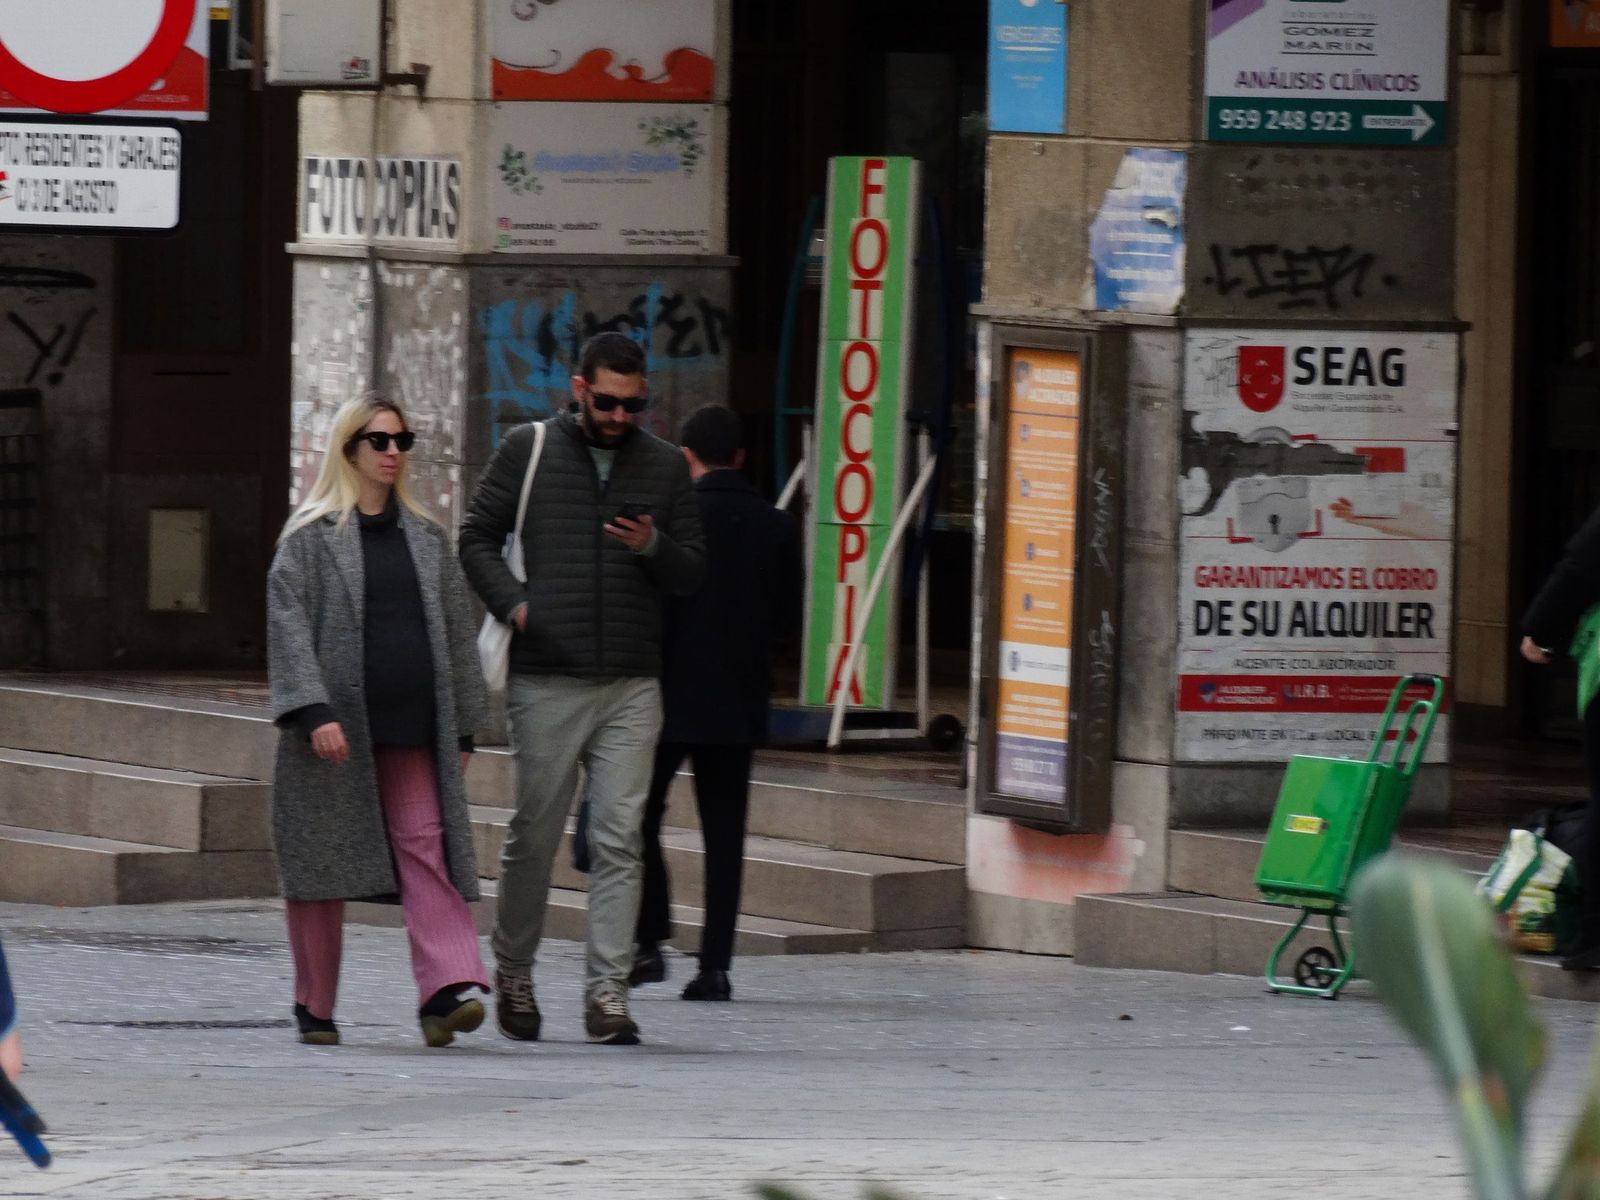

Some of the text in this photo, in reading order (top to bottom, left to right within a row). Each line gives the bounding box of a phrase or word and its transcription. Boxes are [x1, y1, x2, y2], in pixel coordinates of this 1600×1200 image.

[1235, 67, 1420, 92] ANÁLISIS CLÍNICOS
[1219, 109, 1261, 129] 959
[1264, 110, 1307, 130] 248
[1310, 112, 1352, 131] 923
[24, 132, 102, 167] RESIDENTES
[63, 179, 119, 214] AGOSTO
[304, 158, 459, 239] FOTOCOPIAS
[1293, 346, 1406, 387] SEAG
[826, 159, 889, 705] FOTOCOPIA
[1194, 565, 1438, 590] GARANTIZAMOS EL COBRO
[1194, 600, 1435, 638] DE SU ALQUILER
[1233, 658, 1396, 671] AGENTE COLABORADOR
